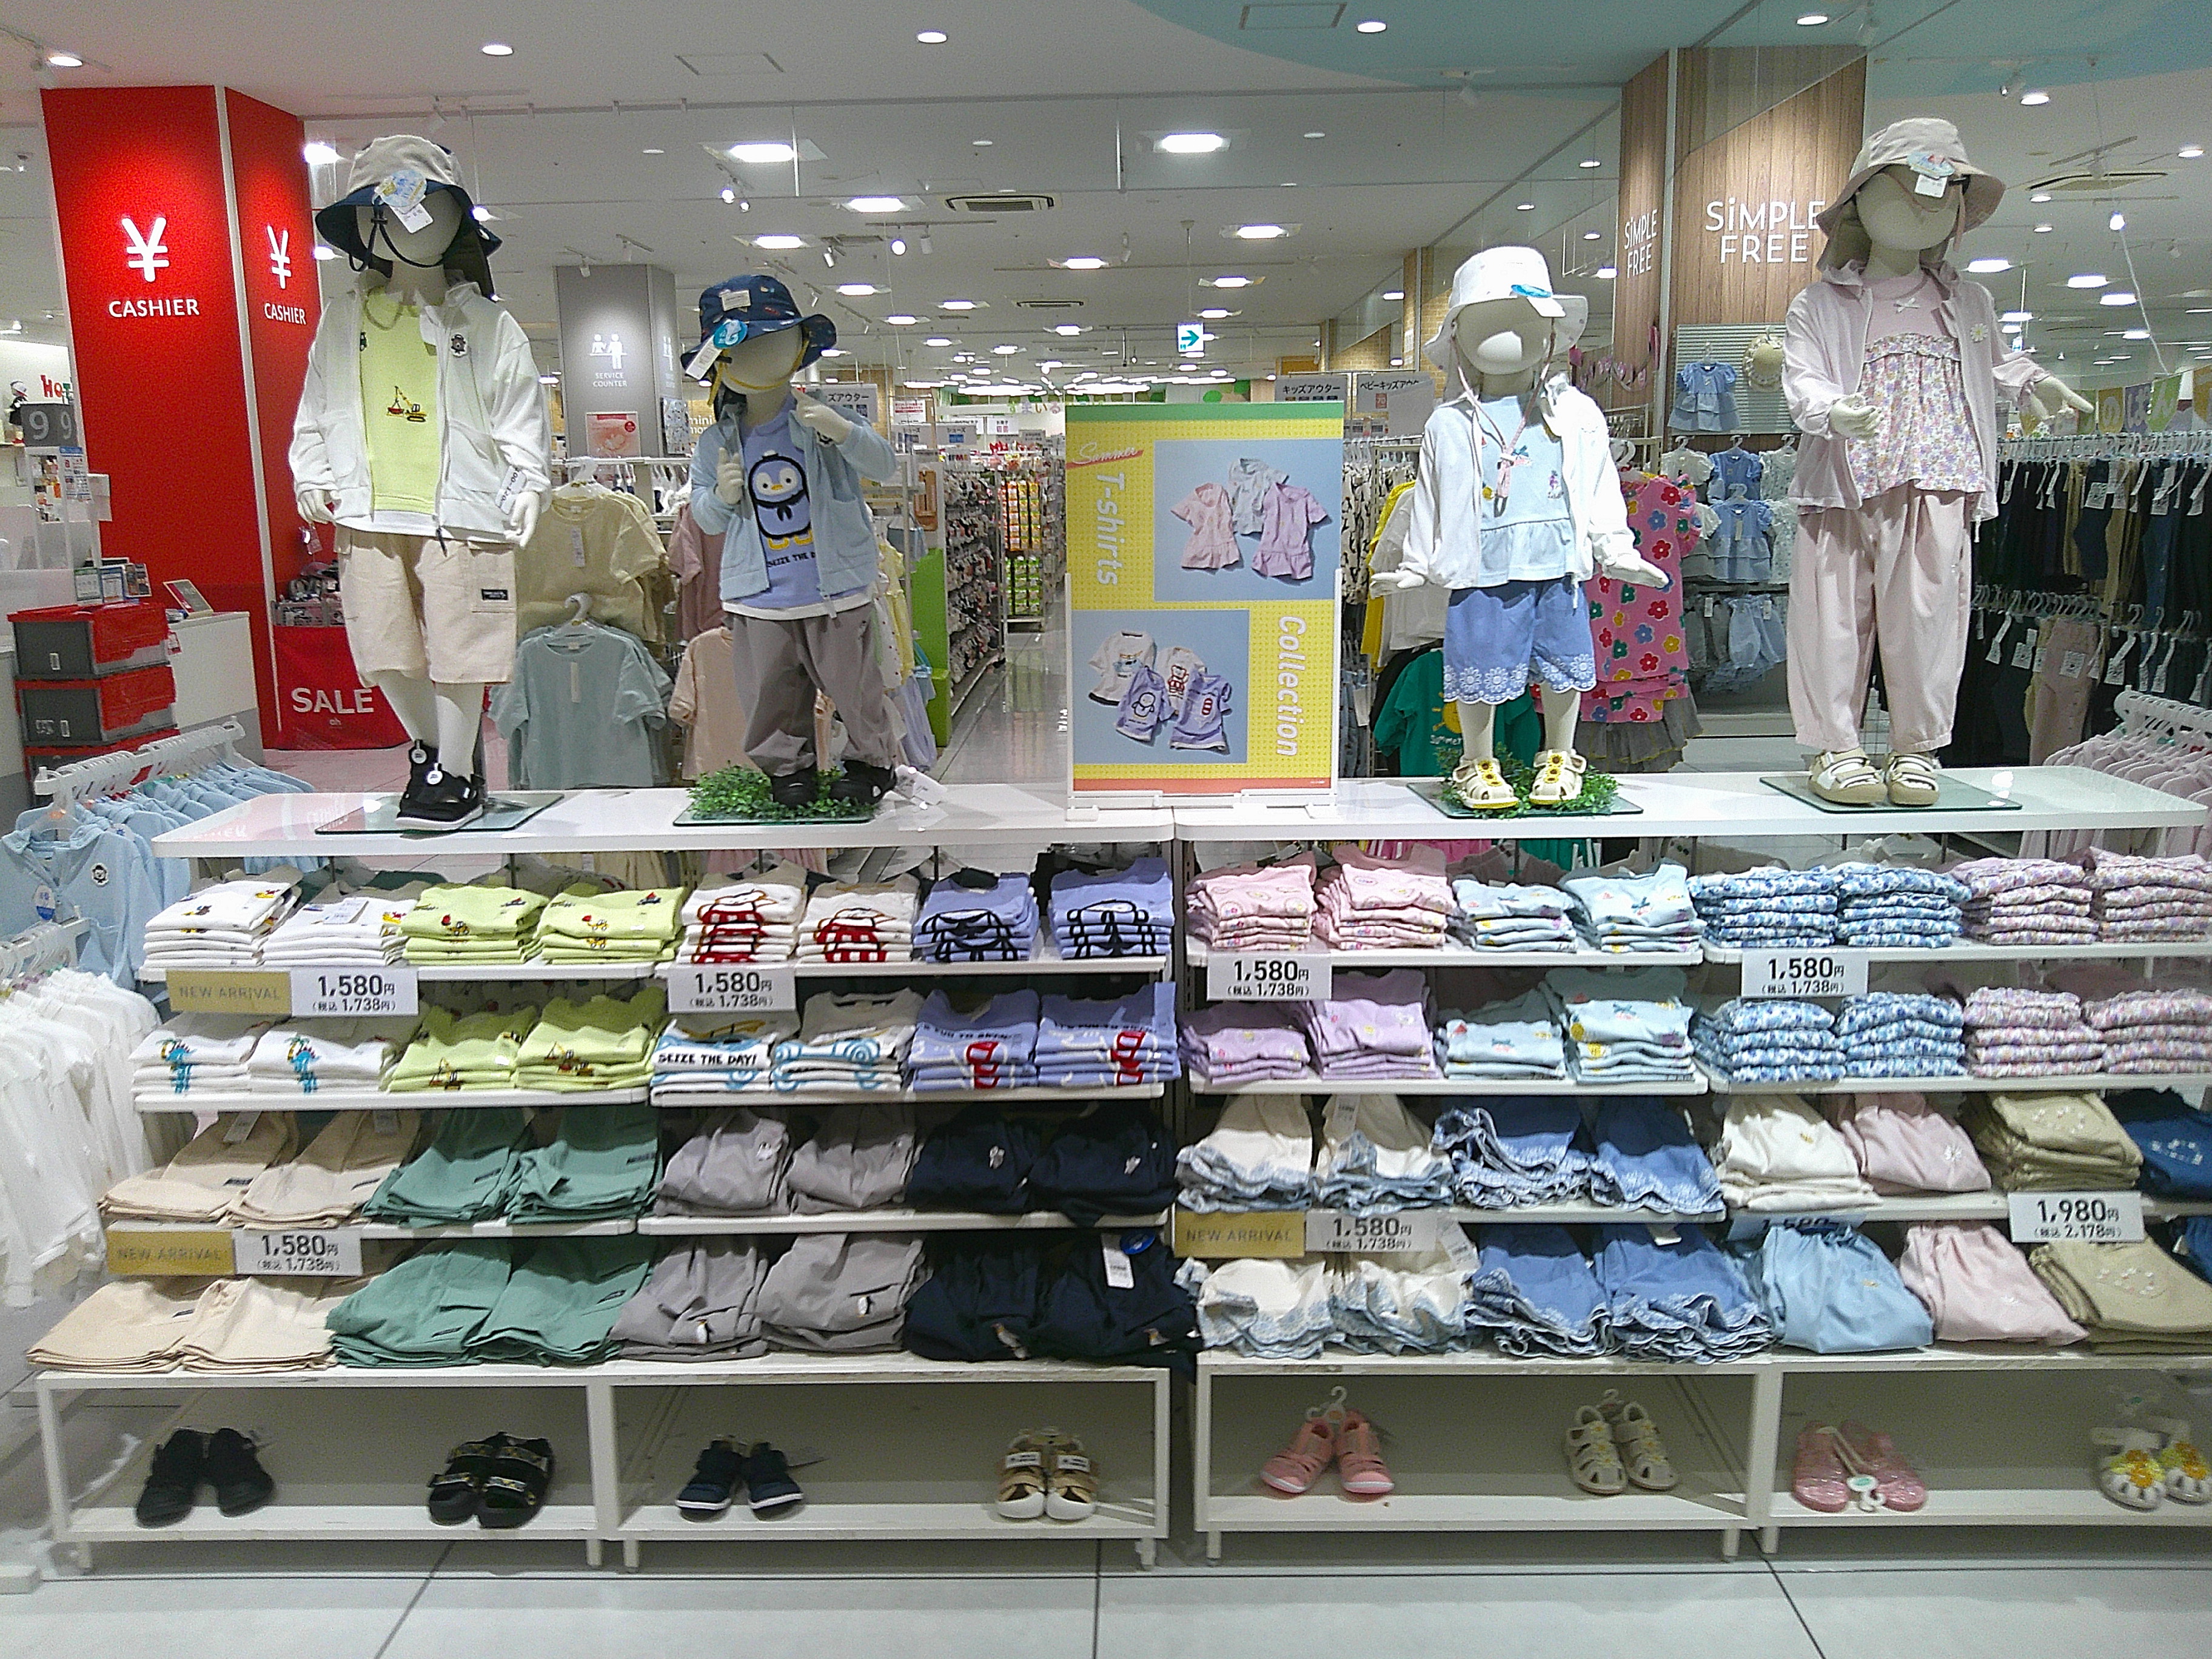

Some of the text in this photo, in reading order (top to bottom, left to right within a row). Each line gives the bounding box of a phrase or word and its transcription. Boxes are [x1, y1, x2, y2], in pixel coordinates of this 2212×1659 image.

[1720, 233, 1809, 264] FREE
[1627, 243, 1652, 278] FREE
[109, 299, 200, 318] CASHIER
[264, 303, 306, 326] CASHIER
[1283, 384, 1341, 394] キッズアウター
[28, 410, 50, 440] 9
[1072, 441, 1139, 465] Summer
[1096, 472, 1125, 586] T-shirts
[1276, 615, 1307, 756] Collection
[291, 687, 374, 714] SALE
[1234, 960, 1309, 981] 1,580円
[1768, 957, 1844, 979] 1,580円
[179, 986, 281, 1000] NEW ARRIVAL
[318, 975, 395, 997] 1,580円
[695, 972, 773, 993] 1,580円
[659, 1053, 695, 1063] SEIZE
[700, 1053, 723, 1065] THE
[2037, 1199, 2119, 1222] 1,980円
[1186, 1229, 1293, 1242] NEW ARRIVAL
[1334, 1217, 1412, 1237] 1,580円
[118, 1247, 221, 1261] NEW ARRIVAL
[261, 1235, 339, 1257] 1,580円
